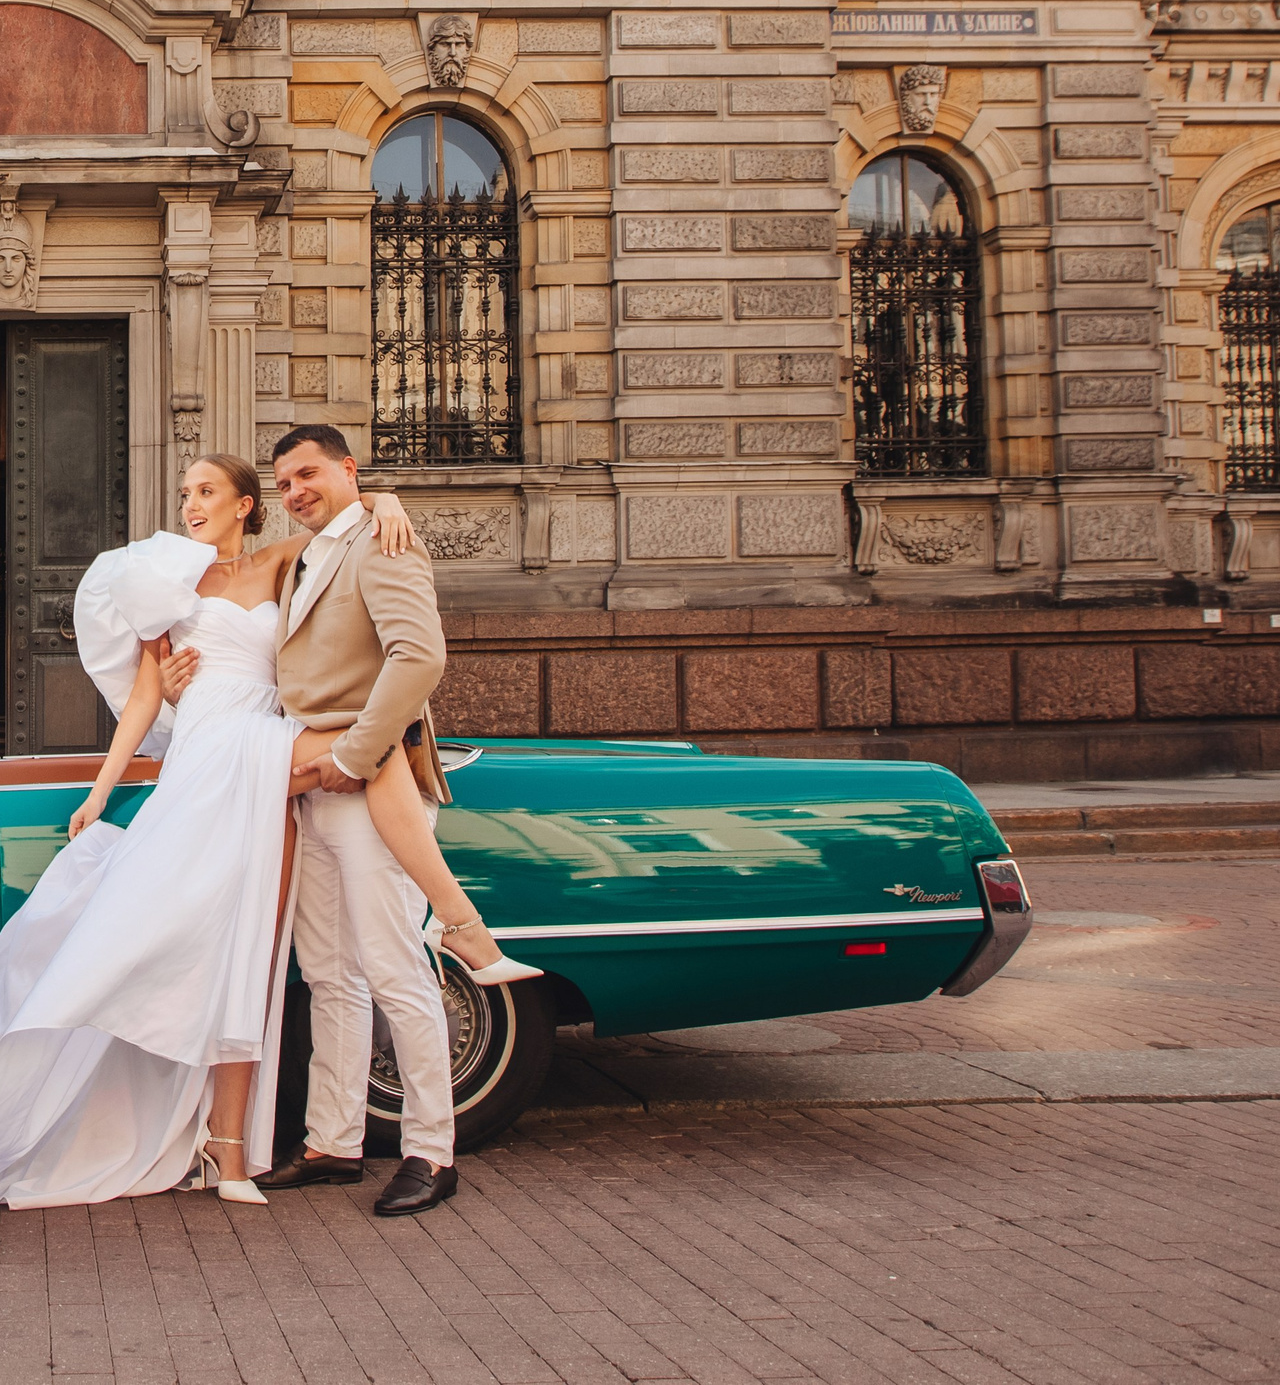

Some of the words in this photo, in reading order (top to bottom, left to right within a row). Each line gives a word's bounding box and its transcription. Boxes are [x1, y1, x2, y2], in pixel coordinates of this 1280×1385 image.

[831, 12, 927, 33] ЖІОВАННИ
[932, 14, 959, 33] ДА
[963, 14, 1023, 33] УДИНЕ
[908, 885, 963, 904] Newport
